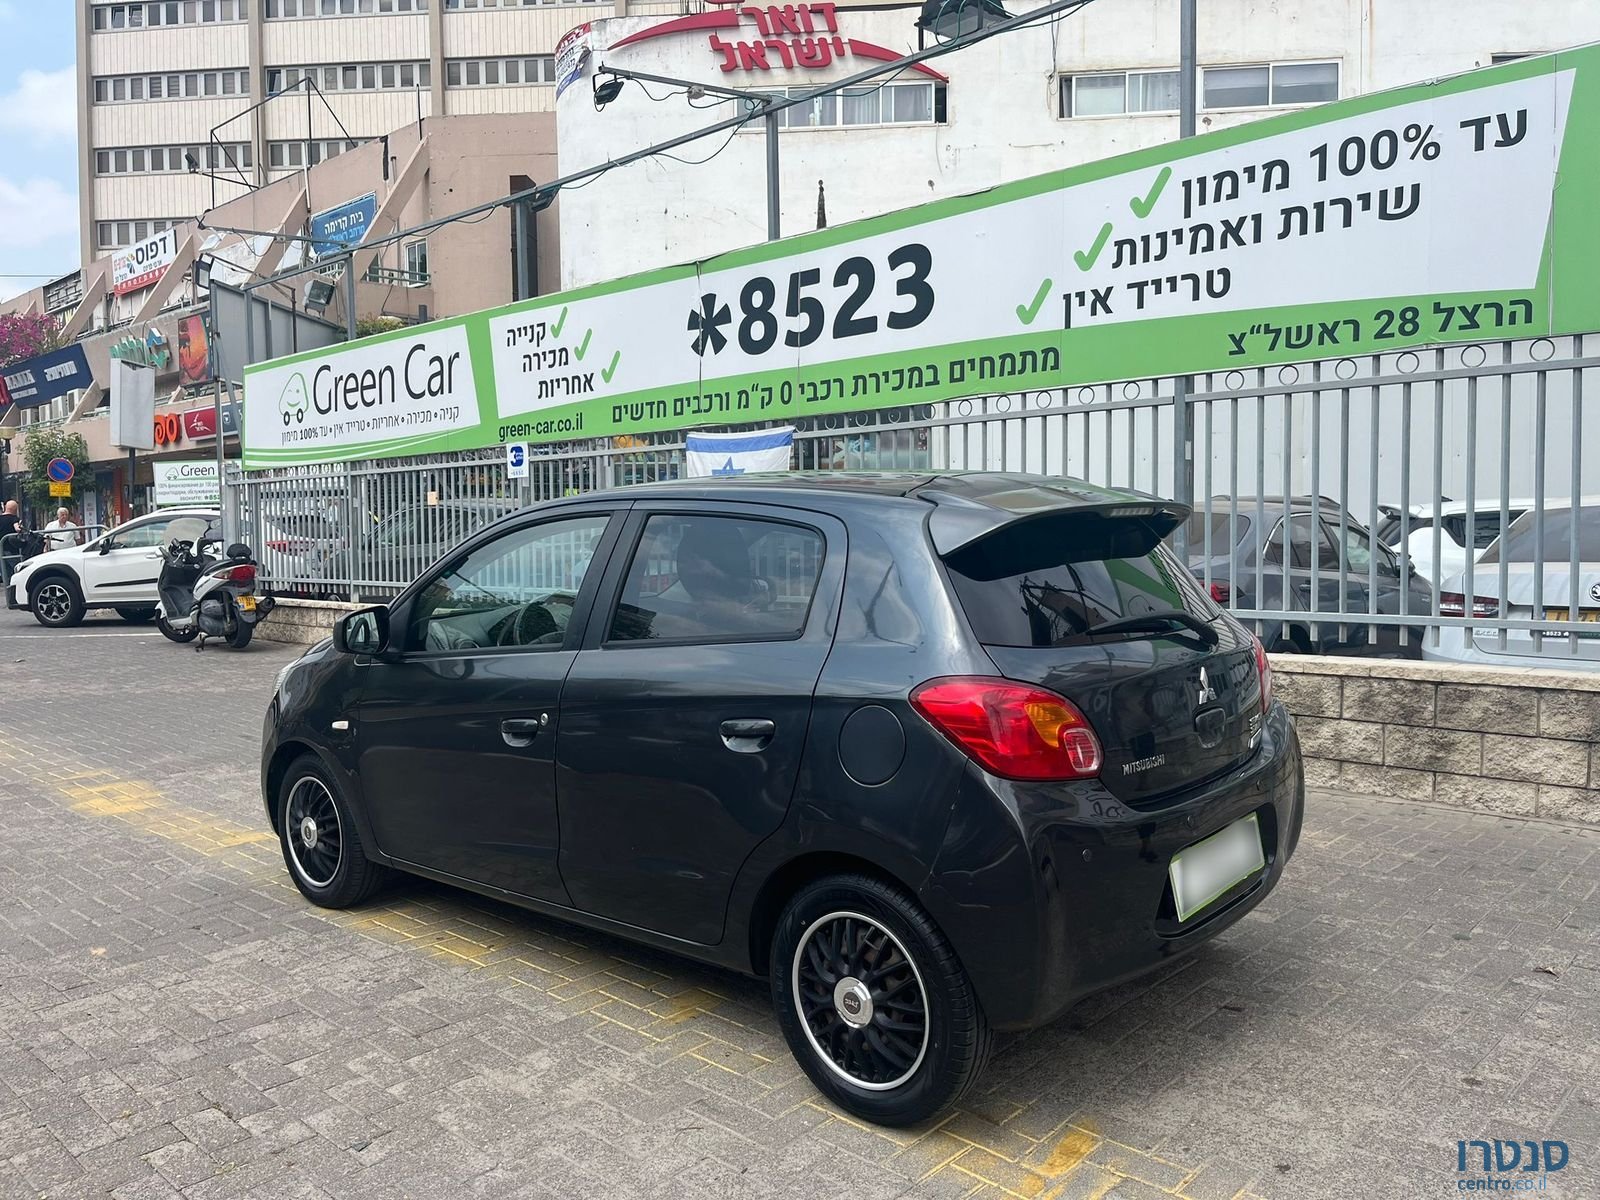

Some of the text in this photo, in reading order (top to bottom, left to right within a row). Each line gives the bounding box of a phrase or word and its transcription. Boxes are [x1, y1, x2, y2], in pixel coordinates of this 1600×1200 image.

[743, 2, 837, 36] דואר
[709, 34, 845, 72] ישראל
[1181, 108, 1528, 218] עד 100% מימון
[350, 211, 364, 225] בית
[1111, 183, 1421, 270] שירות ואמינות
[135, 236, 167, 265] דפוס
[1062, 267, 1231, 329] טרייד אין
[1373, 306, 1420, 339] 28
[1433, 298, 1533, 333] הרצל
[506, 321, 546, 347] קנייה
[522, 347, 569, 373] מכירה
[949, 346, 1060, 384] מתמחים
[312, 344, 460, 416] Green Car
[537, 372, 595, 400] אחריות
[780, 381, 793, 405] 0
[798, 376, 844, 403] רכבי
[851, 365, 940, 397] במכירת
[439, 406, 460, 423] קניה
[612, 400, 667, 423] חדשים
[673, 391, 730, 417] ורכבים
[345, 420, 366, 434] טרייד
[371, 415, 400, 431] אחריות
[406, 410, 432, 425] מכירה
[498, 413, 583, 442] green-car.co.il
[299, 427, 319, 440] 100%
[319, 425, 329, 437] עד
[333, 424, 344, 438] אין
[180, 464, 215, 477] Green
[1121, 753, 1165, 776] MITSUBISHI
